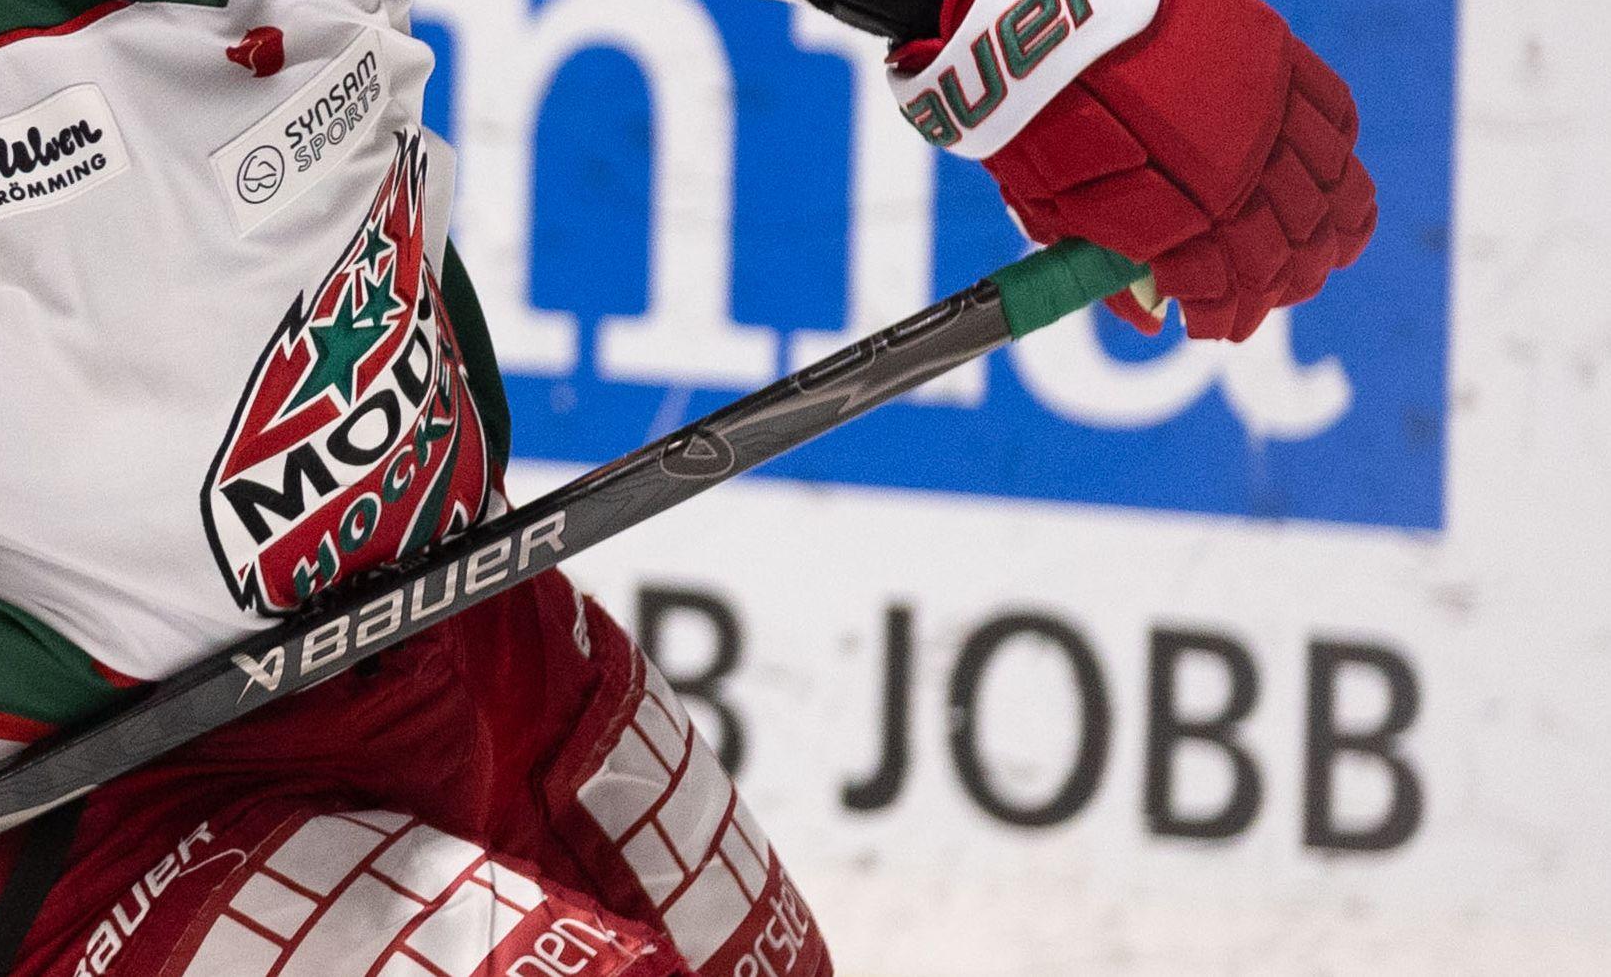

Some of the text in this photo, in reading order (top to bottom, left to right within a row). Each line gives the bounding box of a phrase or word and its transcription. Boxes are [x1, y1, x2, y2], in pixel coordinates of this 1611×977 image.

[285, 50, 377, 149] SYNSAM
[294, 74, 380, 173] SPORTS
[836, 600, 1428, 856] JOBB
